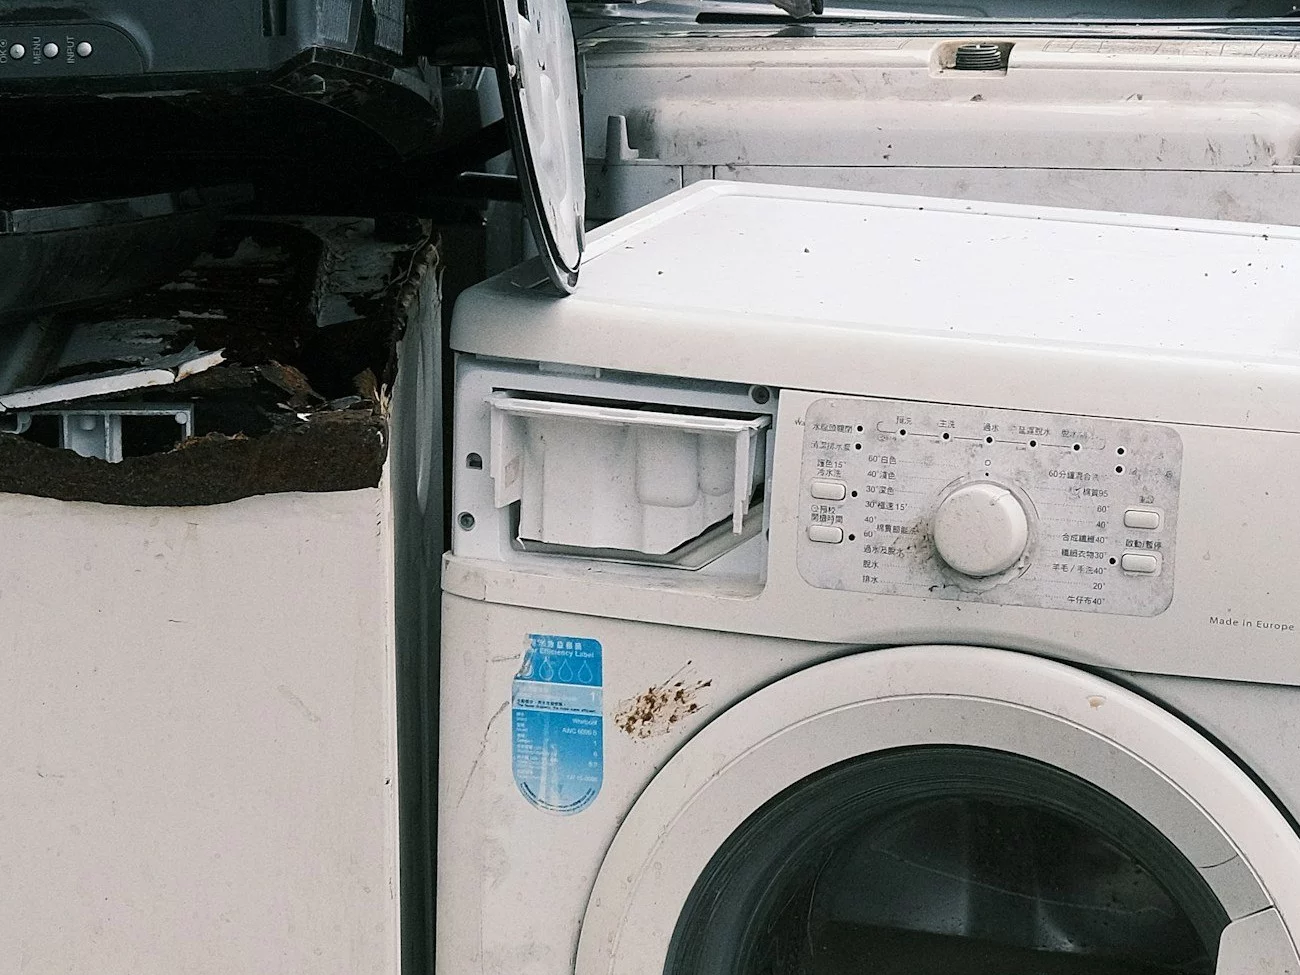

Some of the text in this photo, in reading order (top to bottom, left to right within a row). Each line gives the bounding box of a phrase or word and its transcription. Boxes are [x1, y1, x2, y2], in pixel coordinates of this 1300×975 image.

[67, 36, 75, 63] INPUT
[1209, 616, 1239, 626] Made
[1256, 620, 1295, 631] Europe
